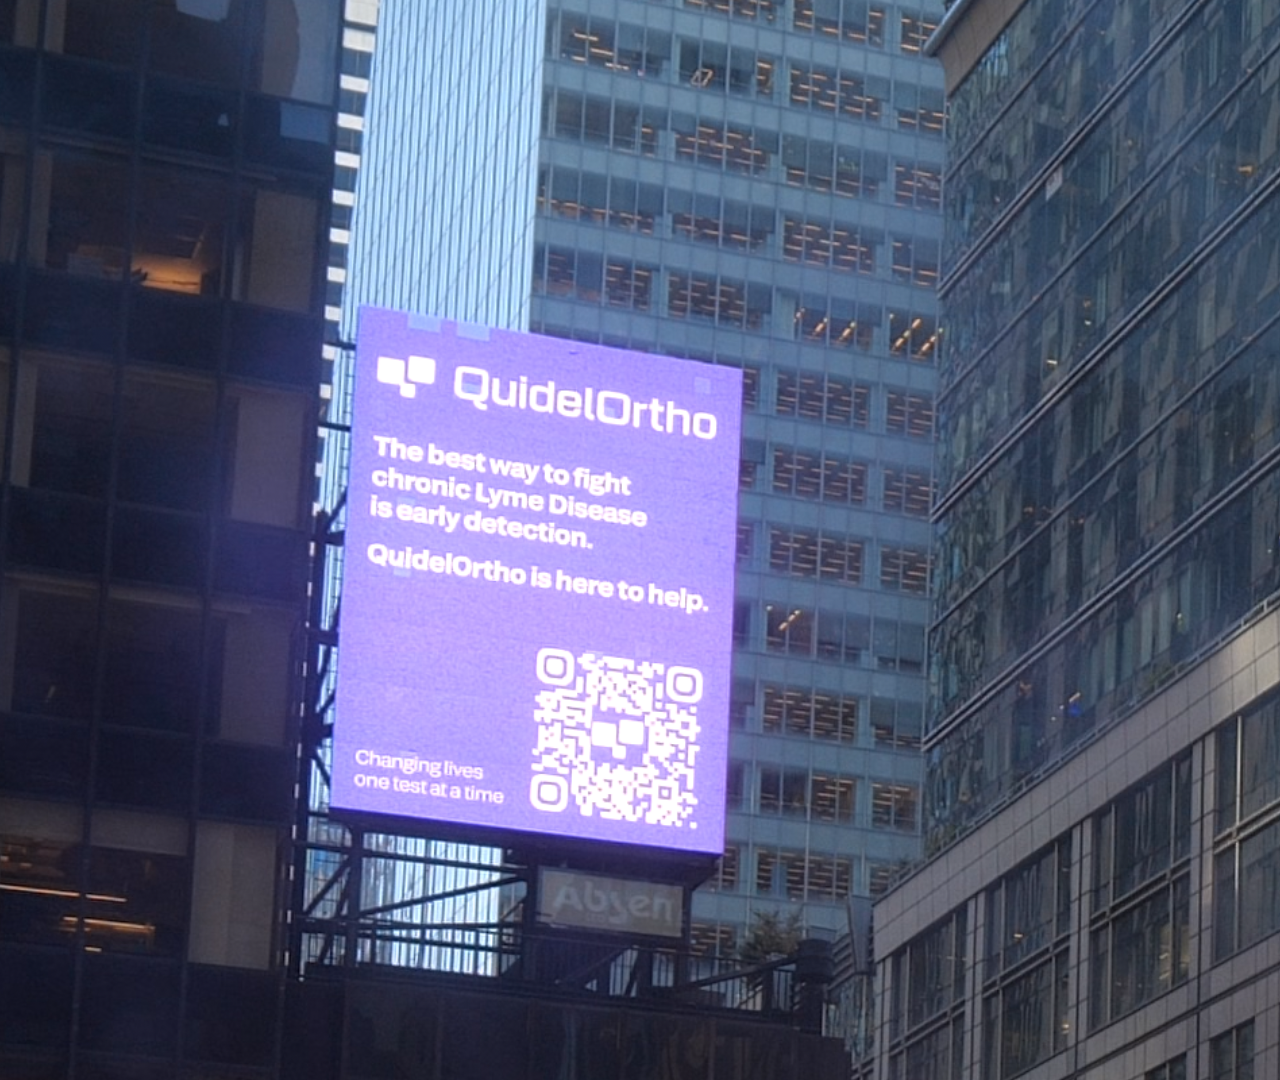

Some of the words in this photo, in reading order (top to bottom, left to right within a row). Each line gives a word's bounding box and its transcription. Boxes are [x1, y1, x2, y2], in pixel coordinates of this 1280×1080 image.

[455, 366, 717, 440] QuidelOrtho
[374, 435, 423, 462] The
[428, 444, 486, 473] best
[490, 458, 539, 484] way
[543, 464, 570, 486] to
[573, 468, 632, 496] fight
[370, 494, 393, 518] is
[396, 505, 461, 533] early
[463, 512, 593, 549] detection.
[371, 468, 471, 500] chronic
[475, 483, 544, 512] Lyme
[549, 494, 648, 528] Disease
[367, 544, 526, 585] QuidelOrtho
[530, 566, 552, 589] is
[556, 570, 615, 598] here
[618, 580, 644, 602] to
[648, 584, 709, 614] help.
[354, 774, 390, 790] one
[393, 777, 427, 795] test
[430, 783, 447, 798] at
[449, 786, 461, 799] a
[464, 785, 505, 804] time
[355, 749, 442, 778] Changing
[444, 760, 483, 780] lives
[553, 880, 673, 924] Absen
